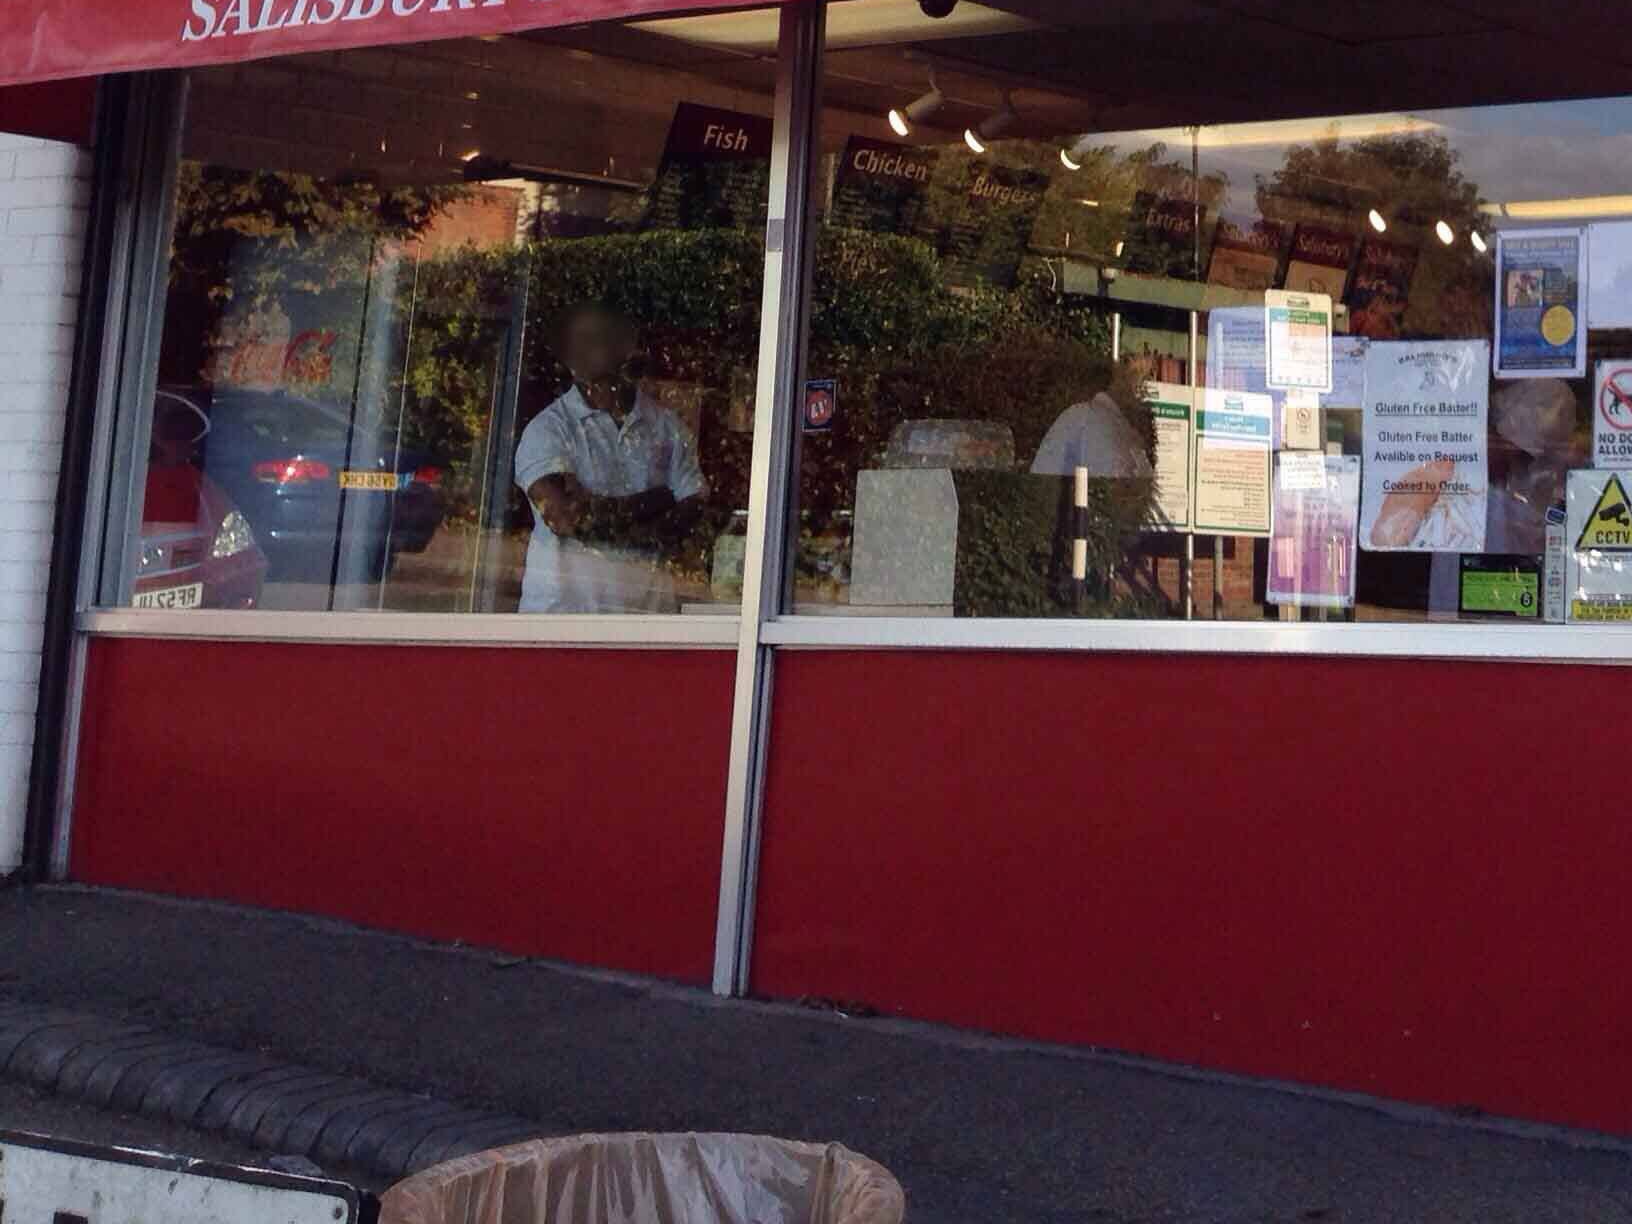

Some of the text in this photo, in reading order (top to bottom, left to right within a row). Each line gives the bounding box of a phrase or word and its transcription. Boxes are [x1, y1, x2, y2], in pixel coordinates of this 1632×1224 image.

[703, 124, 748, 151] Fish
[852, 148, 928, 182] Chicken
[1375, 403, 1410, 416] Gluten
[1413, 403, 1437, 416] Free
[1378, 432, 1473, 445] Gluten Free Batter
[1598, 432, 1617, 446] NO
[1418, 453, 1432, 463] on
[1434, 451, 1479, 466] Request
[1382, 480, 1423, 493] Cooked
[1439, 480, 1470, 493] Order
[1595, 530, 1632, 546] CCTV
